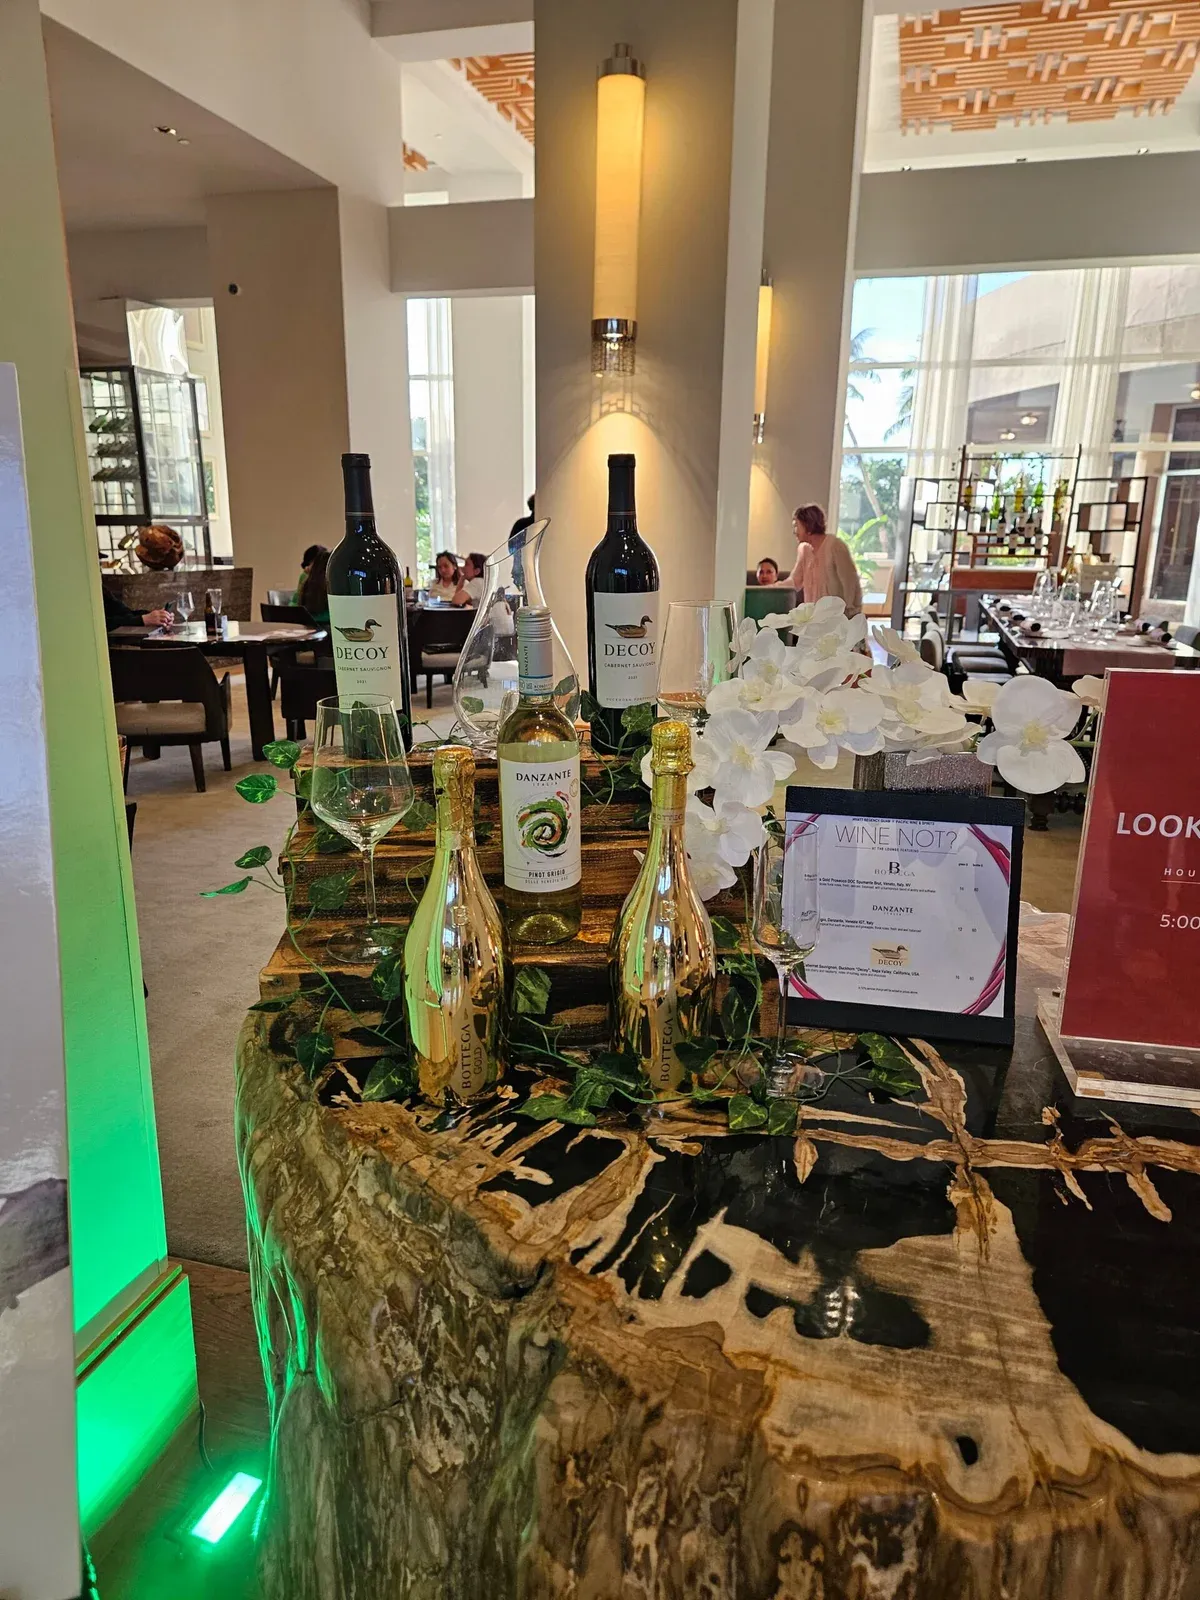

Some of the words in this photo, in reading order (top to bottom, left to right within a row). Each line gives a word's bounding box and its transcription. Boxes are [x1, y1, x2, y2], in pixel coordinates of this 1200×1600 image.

[336, 646, 389, 660] DECOY
[604, 641, 656, 657] DECOY
[516, 769, 571, 782] DANZANTE
[1117, 812, 1200, 838] LOOK
[835, 825, 890, 845] WINE
[898, 828, 958, 850] NOT?
[547, 869, 566, 878] GRIGIO
[888, 862, 900, 874] B
[872, 905, 914, 914] DANZANTE
[1160, 914, 1200, 930] 5:00
[461, 1024, 472, 1089] BOTTEGA
[660, 1018, 674, 1082] BOTTEGA
[474, 1046, 483, 1074] GOLD
